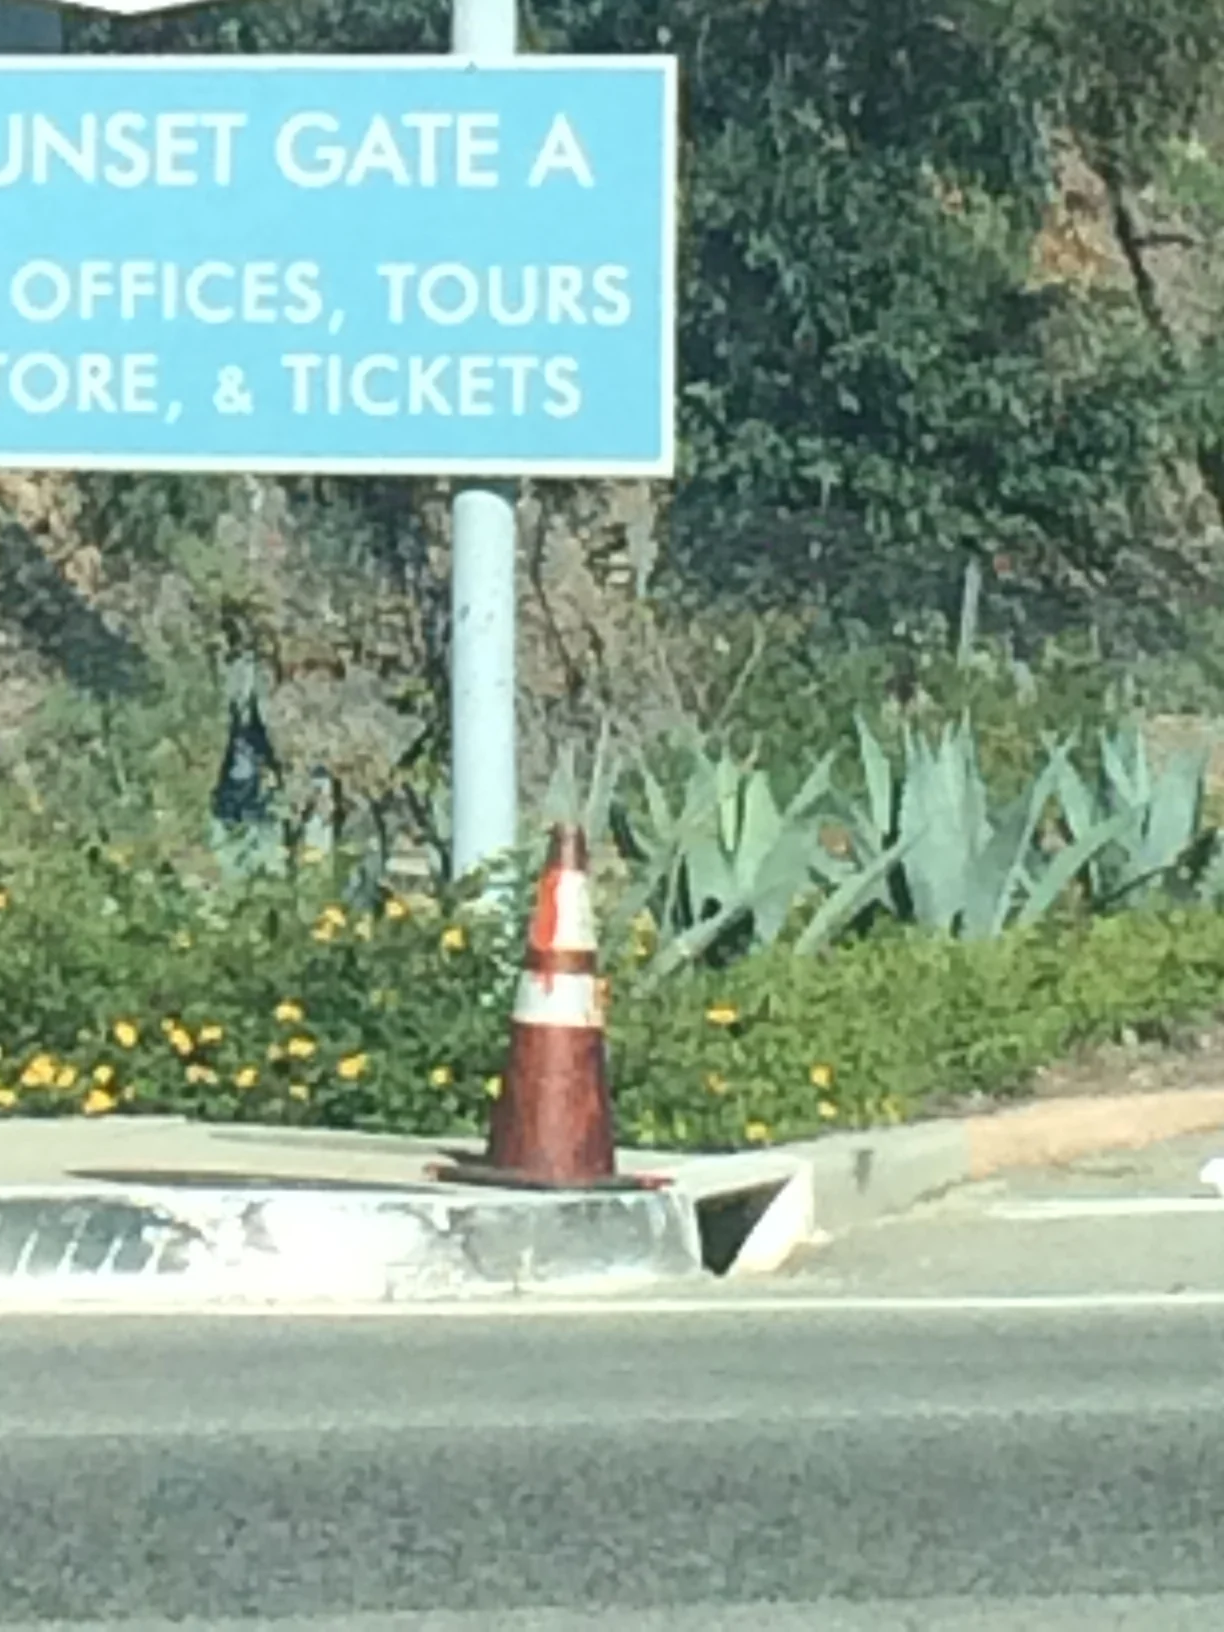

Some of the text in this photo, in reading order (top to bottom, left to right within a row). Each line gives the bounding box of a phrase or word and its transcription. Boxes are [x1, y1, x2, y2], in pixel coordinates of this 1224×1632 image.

[274, 112, 500, 188] GATE
[529, 114, 595, 188] A
[10, 259, 344, 333] OFFICES,
[377, 262, 632, 326] TOURS
[213, 365, 254, 415] &
[282, 353, 582, 419] TICKETS
